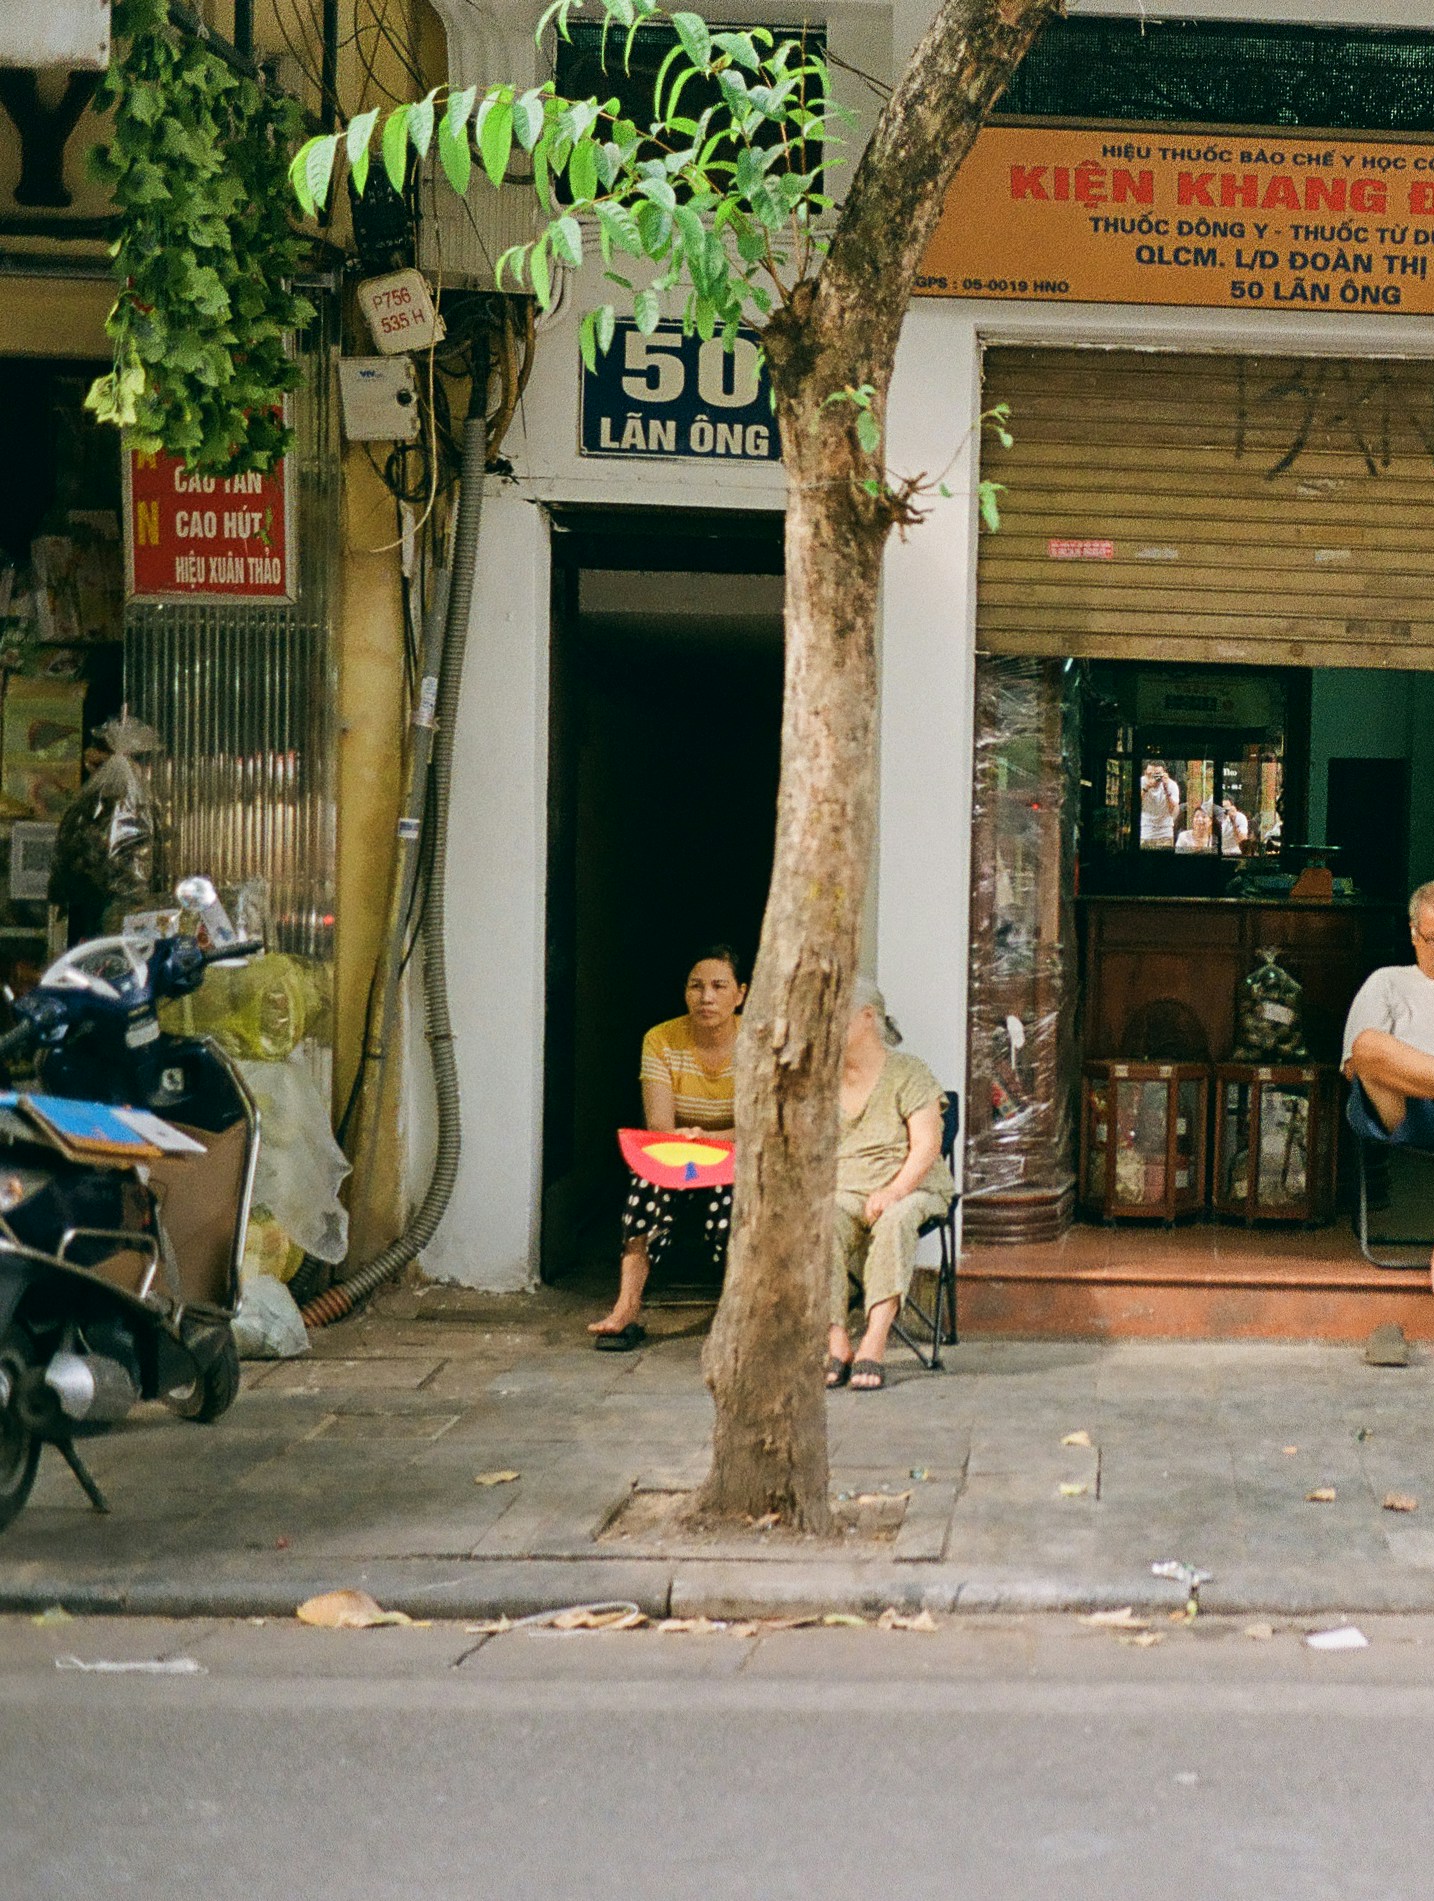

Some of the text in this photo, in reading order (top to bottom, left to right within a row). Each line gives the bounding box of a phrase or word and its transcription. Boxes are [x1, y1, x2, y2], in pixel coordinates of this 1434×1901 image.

[1102, 143, 1151, 162] HIỆU
[1158, 144, 1233, 163] THUỐC
[1293, 149, 1336, 167] CHẾ
[1341, 154, 1355, 168] Y
[1362, 155, 1407, 173] HỌC
[1010, 160, 1154, 208] KIỆN
[1178, 172, 1388, 215] KHANG
[1089, 211, 1169, 236] THUỐC
[1253, 222, 1269, 240] Y
[1289, 218, 1369, 243] THUỐC
[1376, 224, 1409, 245] TỪ
[1136, 244, 1226, 268] QLCM.
[1383, 253, 1427, 281] THỊ
[1231, 277, 1401, 305] 50 LÃN ÔNG
[621, 330, 760, 409] 50
[600, 412, 769, 457] LÃN ÔNG
[175, 505, 263, 539] CAO HÚT
[175, 547, 282, 589] HIỆU XUÂN THẢO
